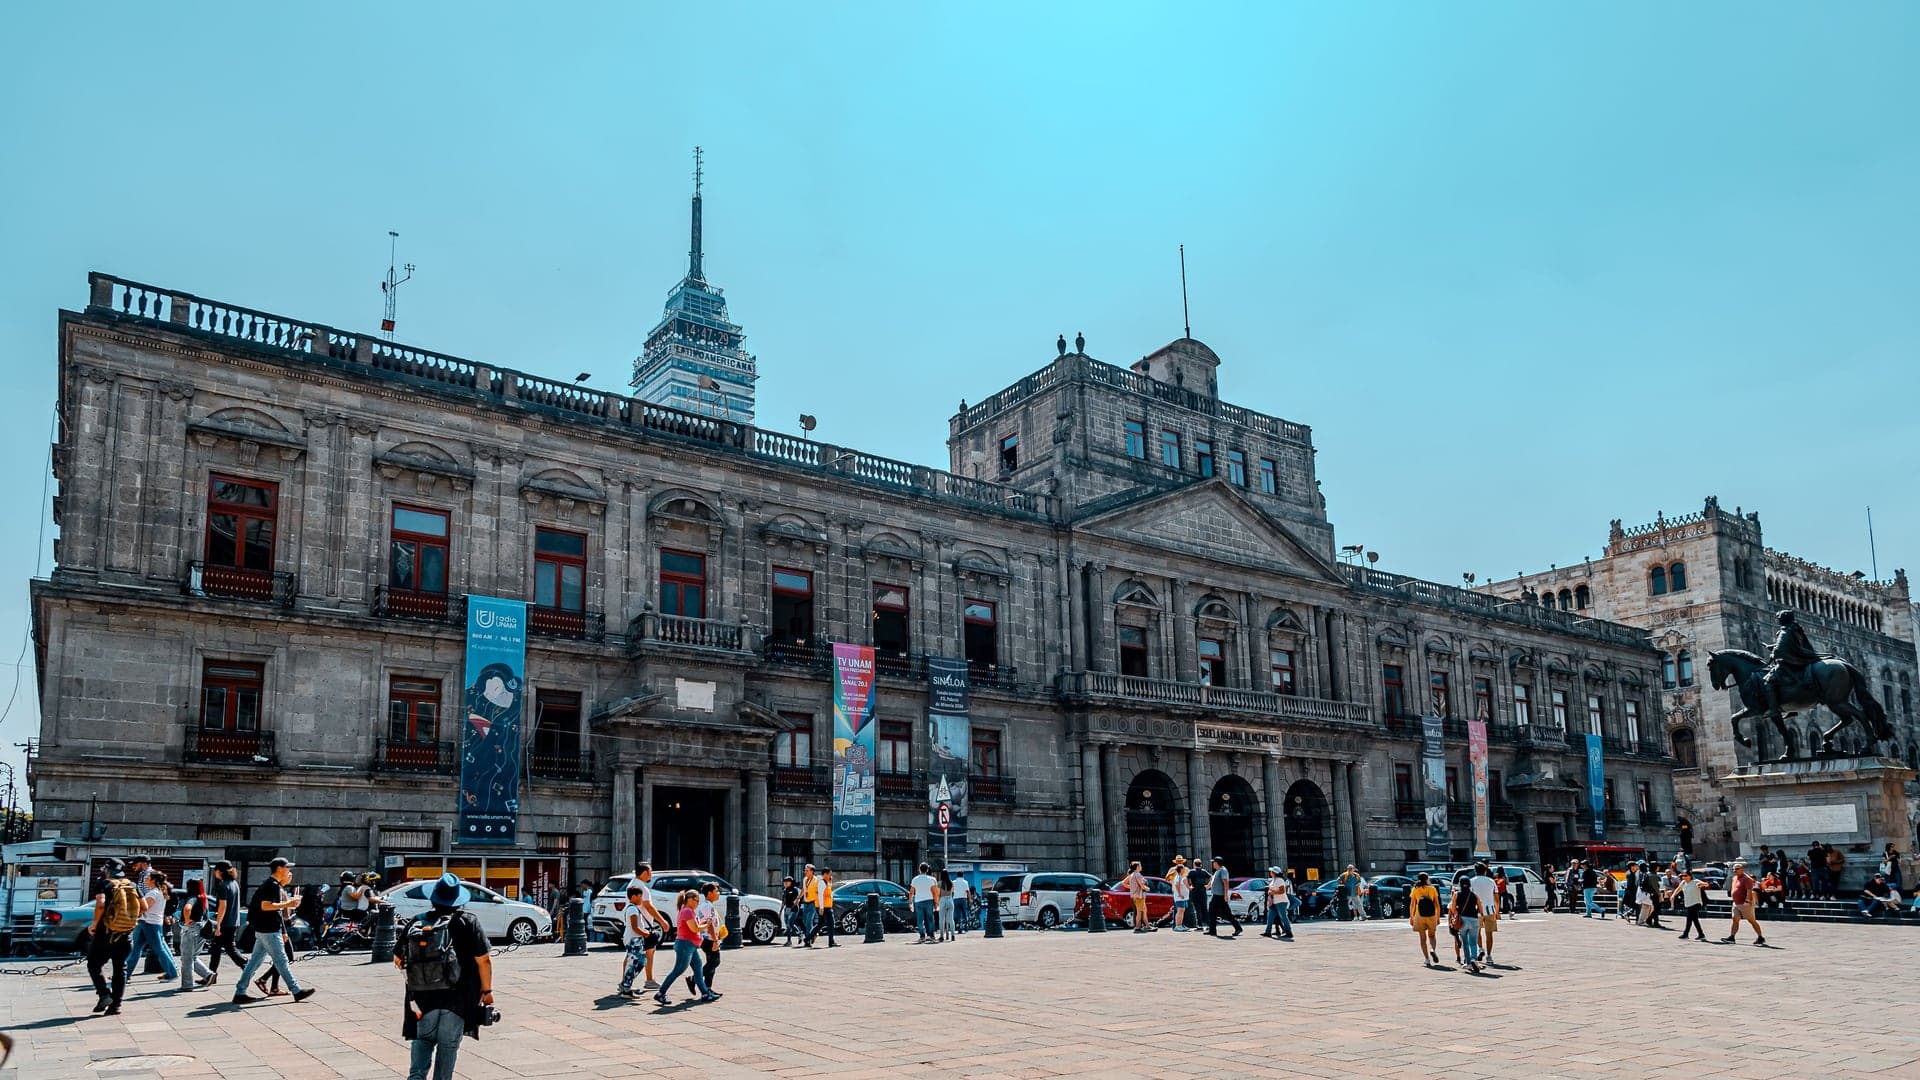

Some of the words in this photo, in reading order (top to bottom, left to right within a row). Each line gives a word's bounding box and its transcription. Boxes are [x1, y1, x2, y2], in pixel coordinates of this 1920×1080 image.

[836, 656, 847, 666] TV
[848, 658, 872, 669] UNAM
[841, 679, 858, 687] CANAL
[933, 674, 966, 688] SINALOA
